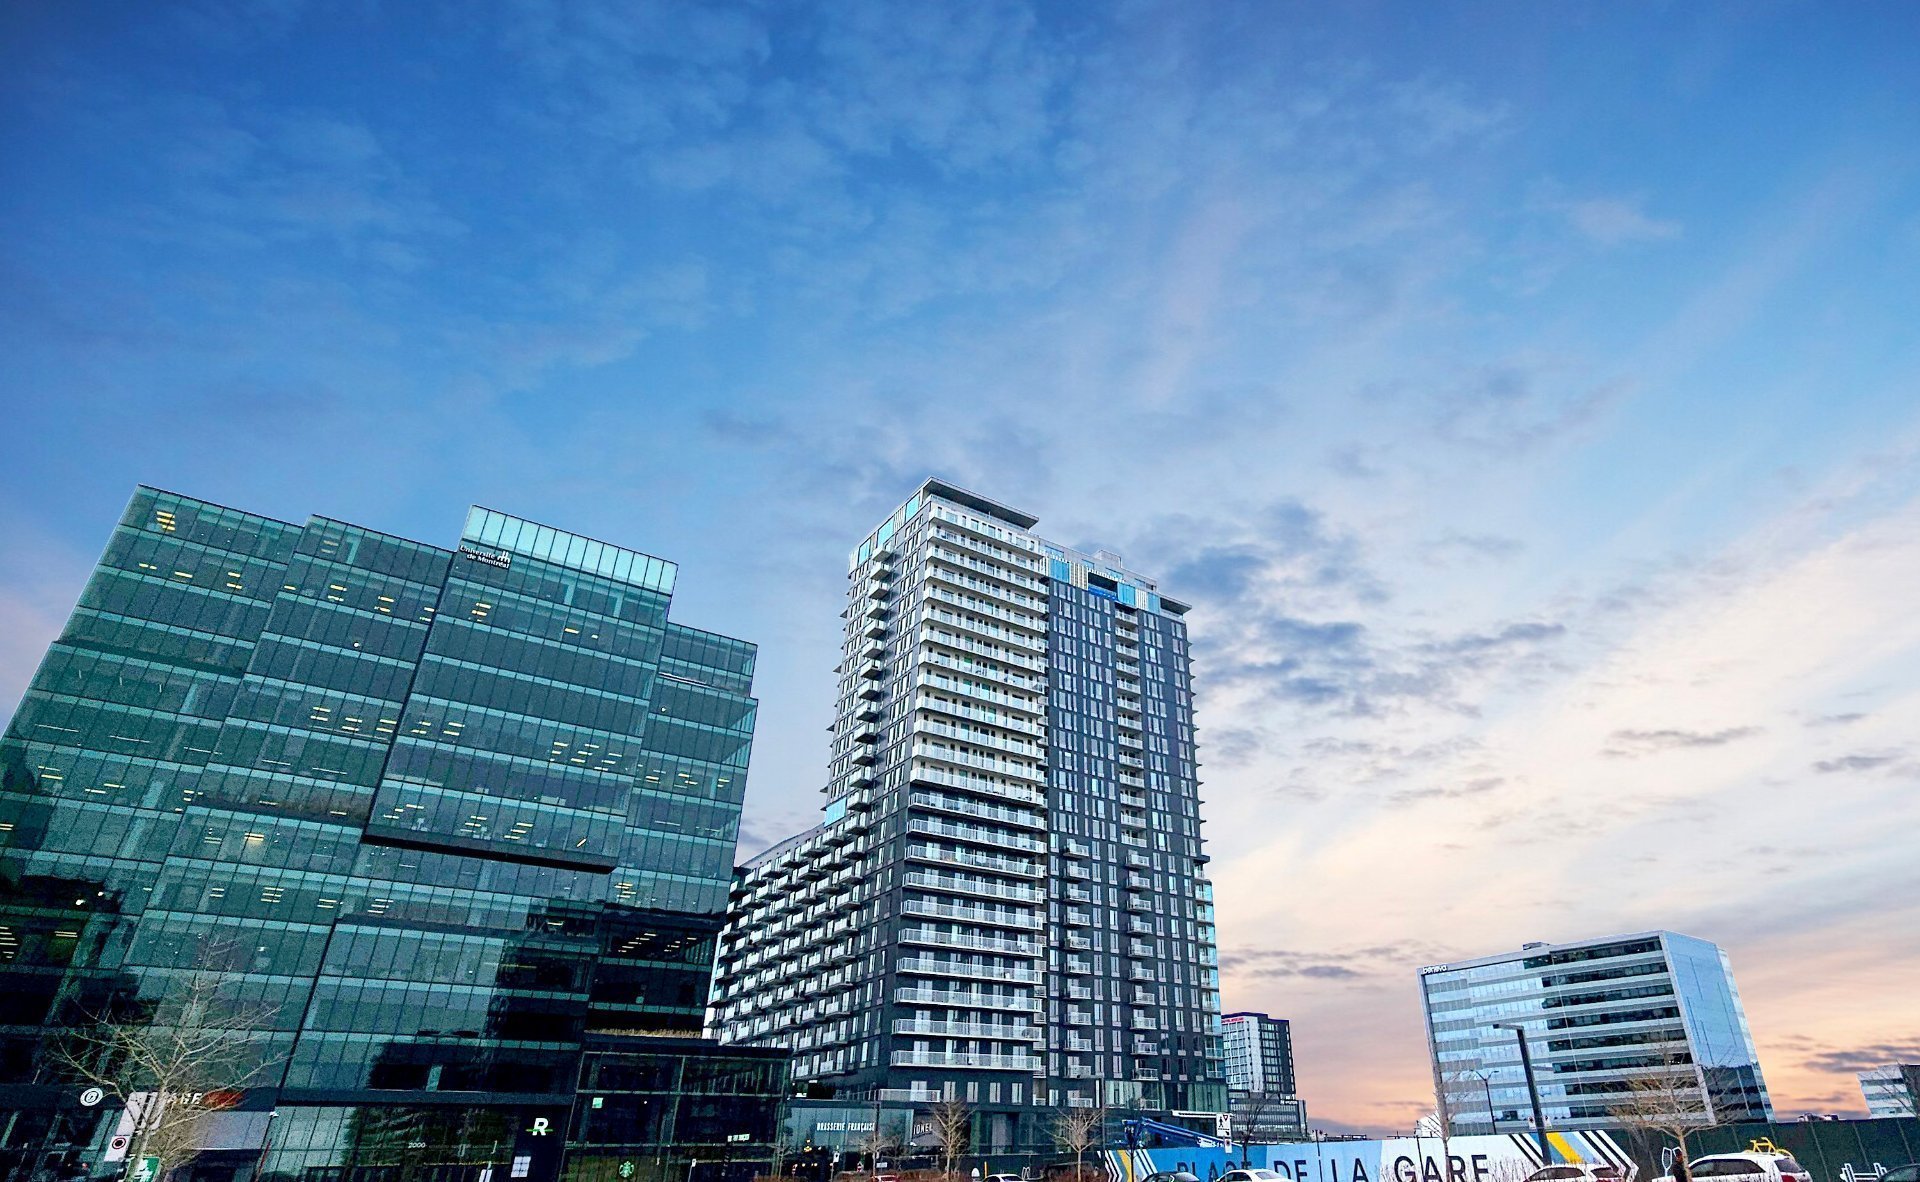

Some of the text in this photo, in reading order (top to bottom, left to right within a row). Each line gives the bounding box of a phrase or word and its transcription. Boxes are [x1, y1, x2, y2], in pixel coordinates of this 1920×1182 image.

[477, 555, 510, 569] Montréal
[1422, 964, 1447, 974] beneva
[816, 1122, 846, 1132] BRASSERIE
